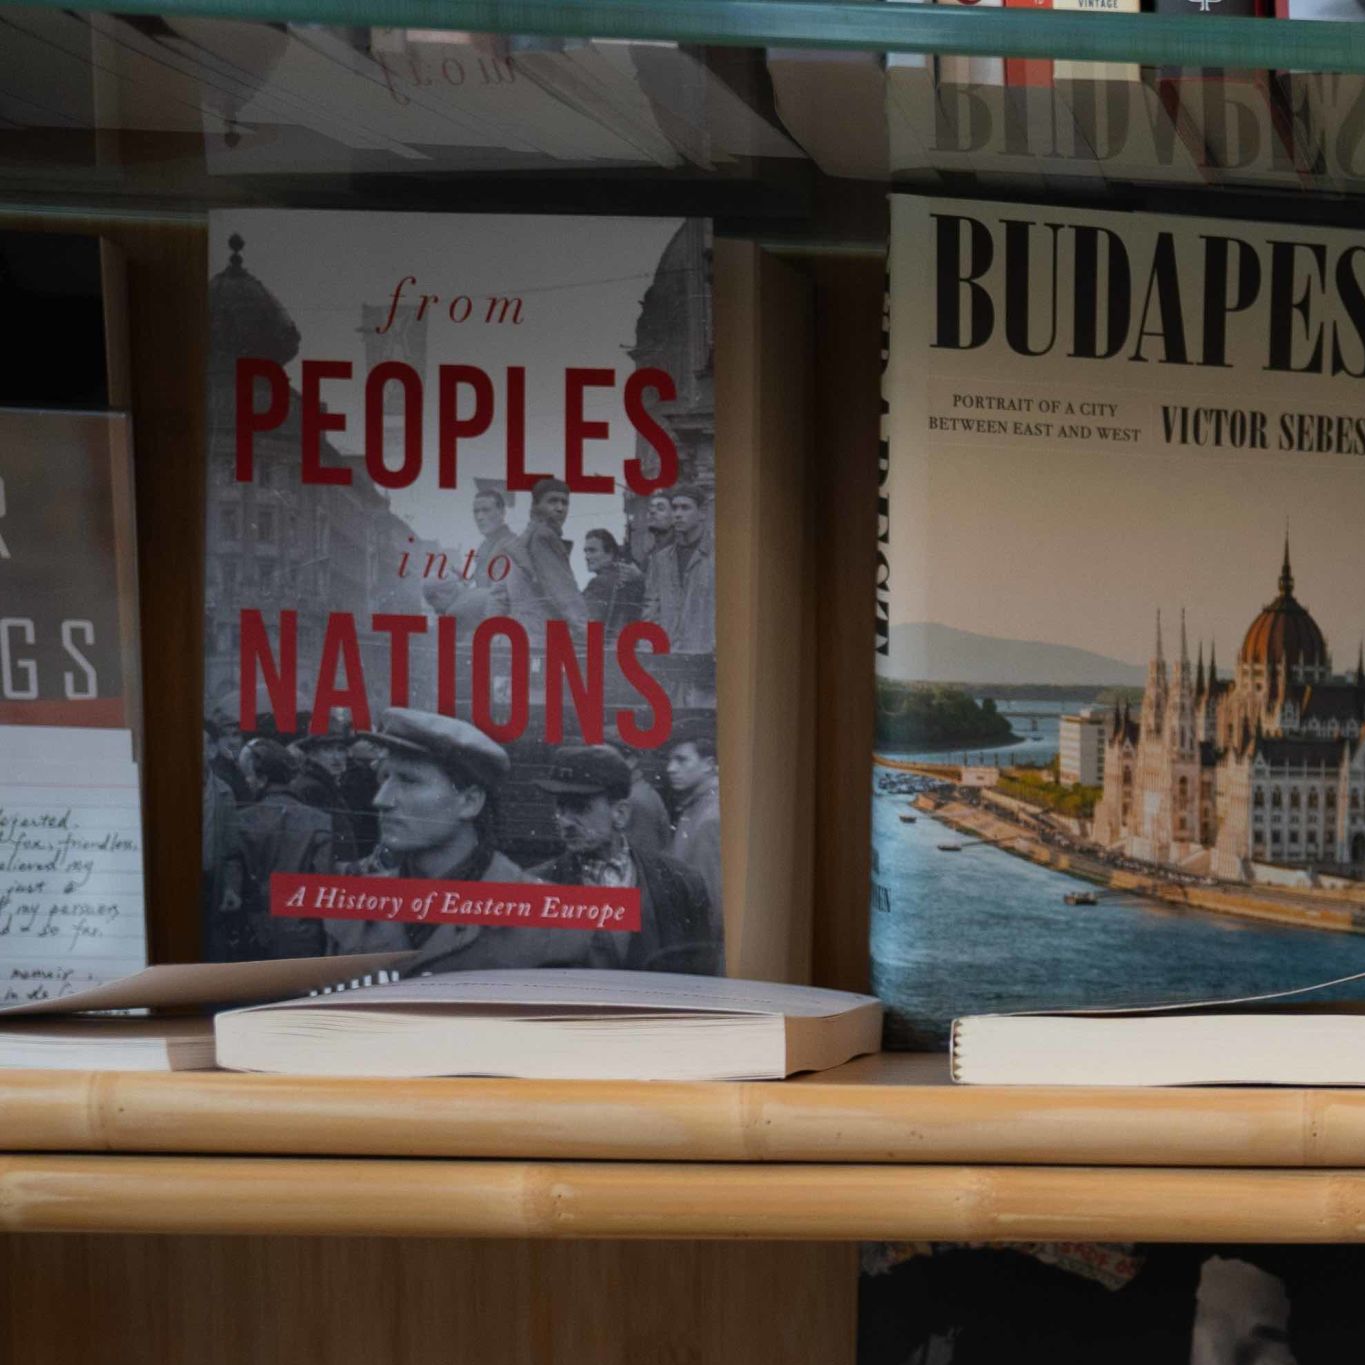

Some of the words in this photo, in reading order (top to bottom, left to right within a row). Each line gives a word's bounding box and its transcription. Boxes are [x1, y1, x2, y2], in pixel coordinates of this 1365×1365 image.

[376, 276, 525, 334] from
[235, 357, 679, 497] PEOPLES
[952, 394, 1029, 414] PORTRAIT
[1038, 398, 1061, 414] OF
[1066, 399, 1076, 415] A
[1079, 400, 1119, 418] CITY
[1161, 404, 1268, 450] VICTOR
[928, 417, 1009, 436] BETWEEN
[1013, 421, 1052, 438] EAST
[1058, 424, 1092, 440] AND
[1096, 426, 1141, 442] WEST
[398, 537, 513, 583] into
[240, 609, 673, 750] NATIONS
[286, 886, 307, 907] A
[313, 888, 403, 916] History
[408, 890, 436, 921] of
[442, 892, 532, 917] Eastern
[541, 896, 625, 926] Europe
